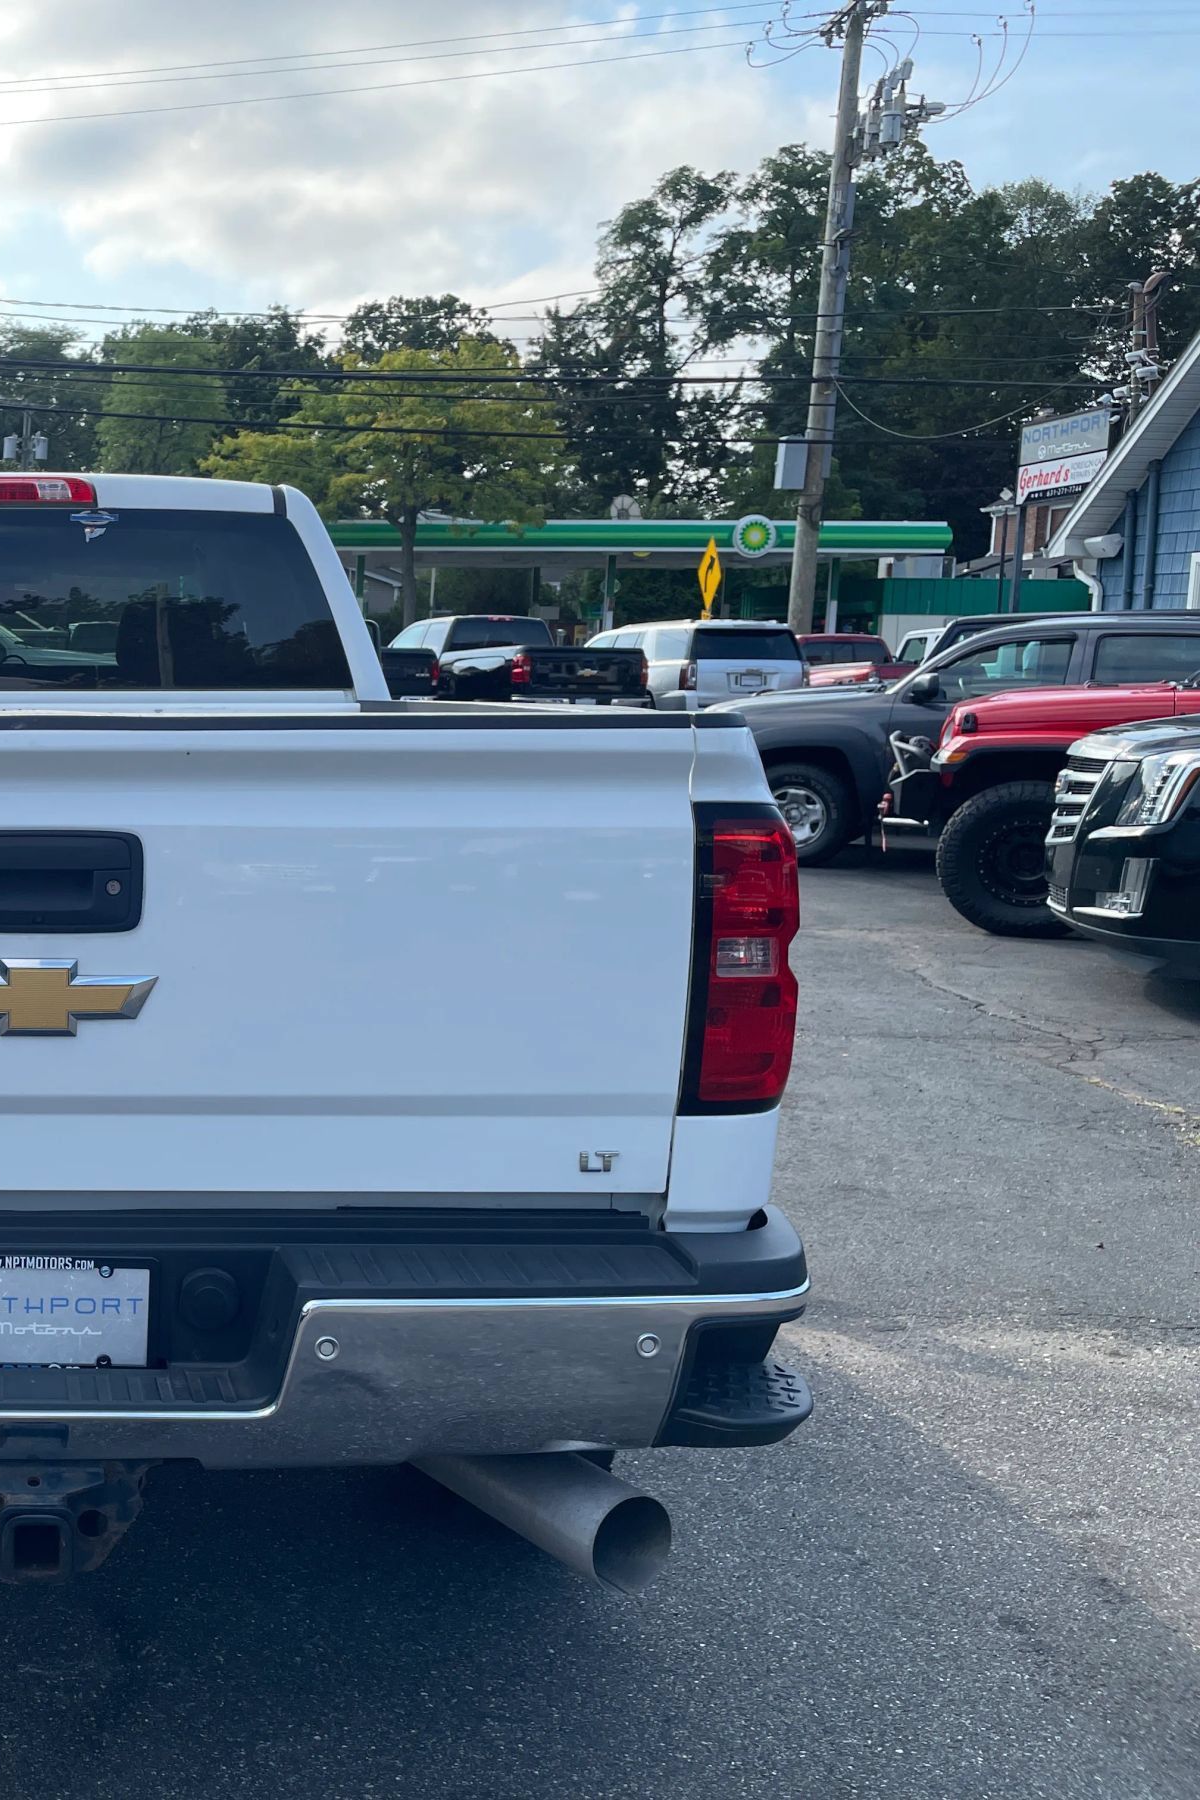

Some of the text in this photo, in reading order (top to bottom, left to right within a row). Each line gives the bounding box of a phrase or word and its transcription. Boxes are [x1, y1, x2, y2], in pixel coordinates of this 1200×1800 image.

[1023, 412, 1110, 445] NORTHPORT
[1047, 441, 1092, 455] Motors
[1019, 464, 1070, 496] Gerhard's
[579, 1150, 620, 1172] LT
